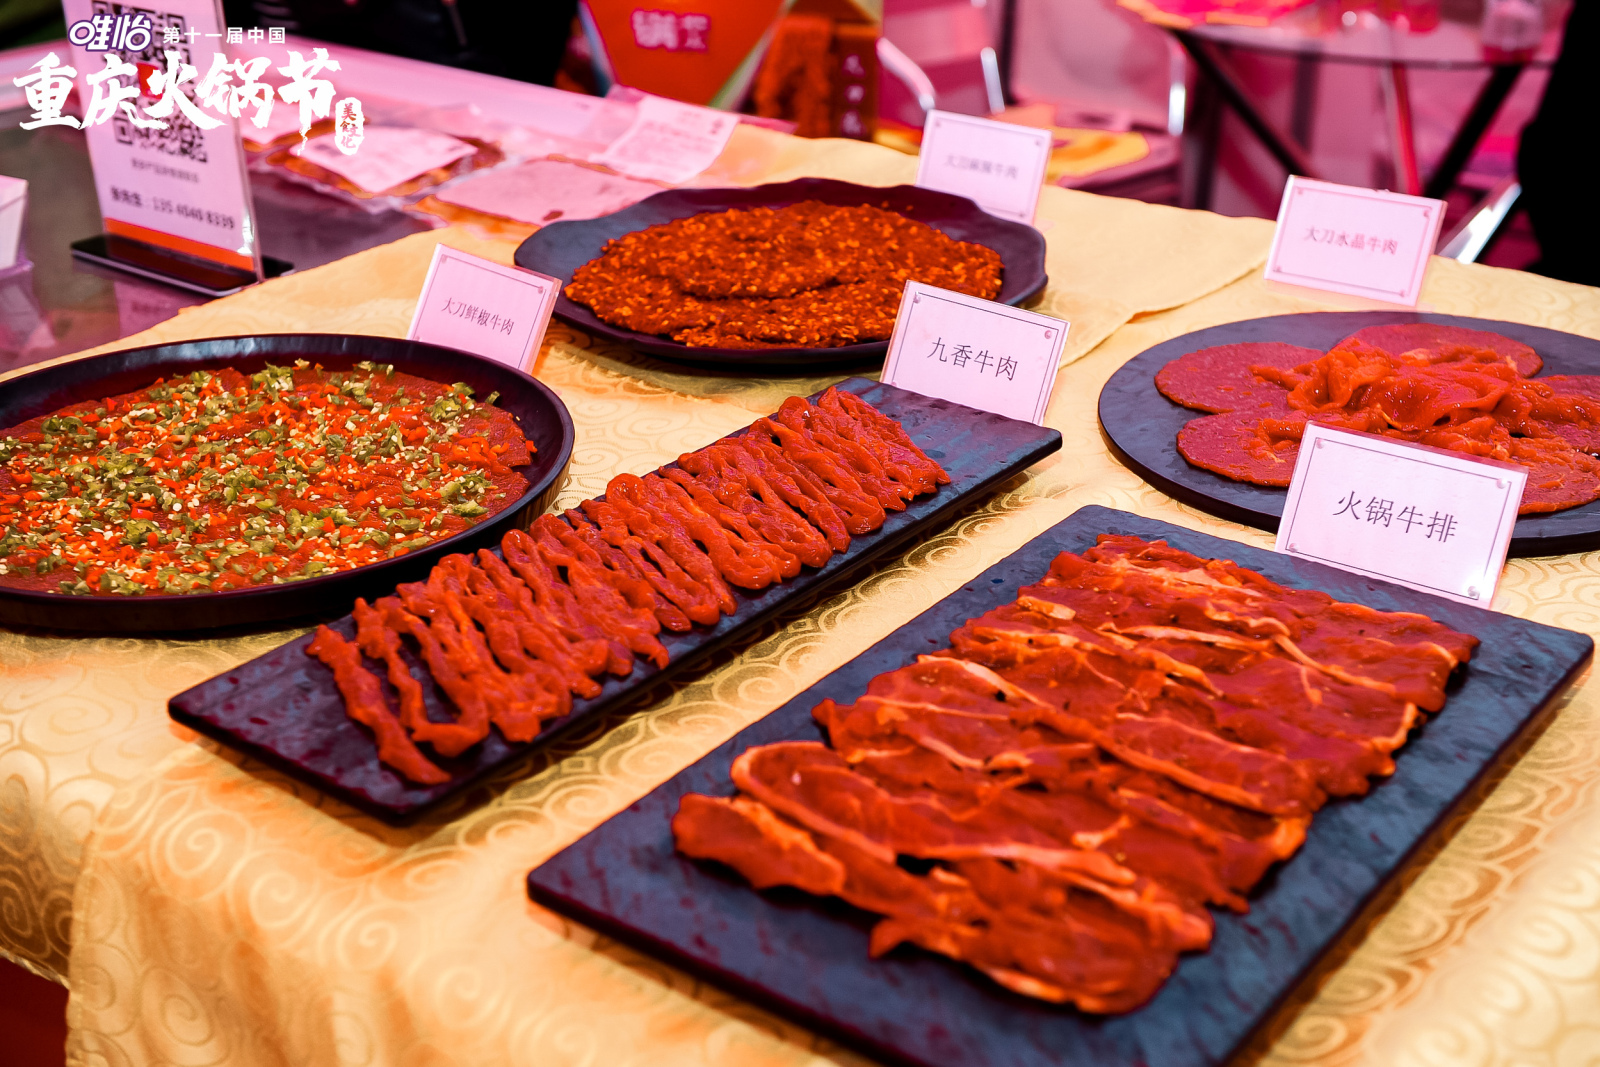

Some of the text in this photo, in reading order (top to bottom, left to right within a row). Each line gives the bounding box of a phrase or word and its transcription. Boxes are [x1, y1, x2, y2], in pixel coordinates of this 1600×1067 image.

[1303, 226, 1399, 256] 大刀水晶牛肉
[441, 297, 515, 336] 大刀鲜椒牛肉
[927, 337, 1019, 381] 九香牛肉
[1332, 490, 1459, 543] 火锅牛排
